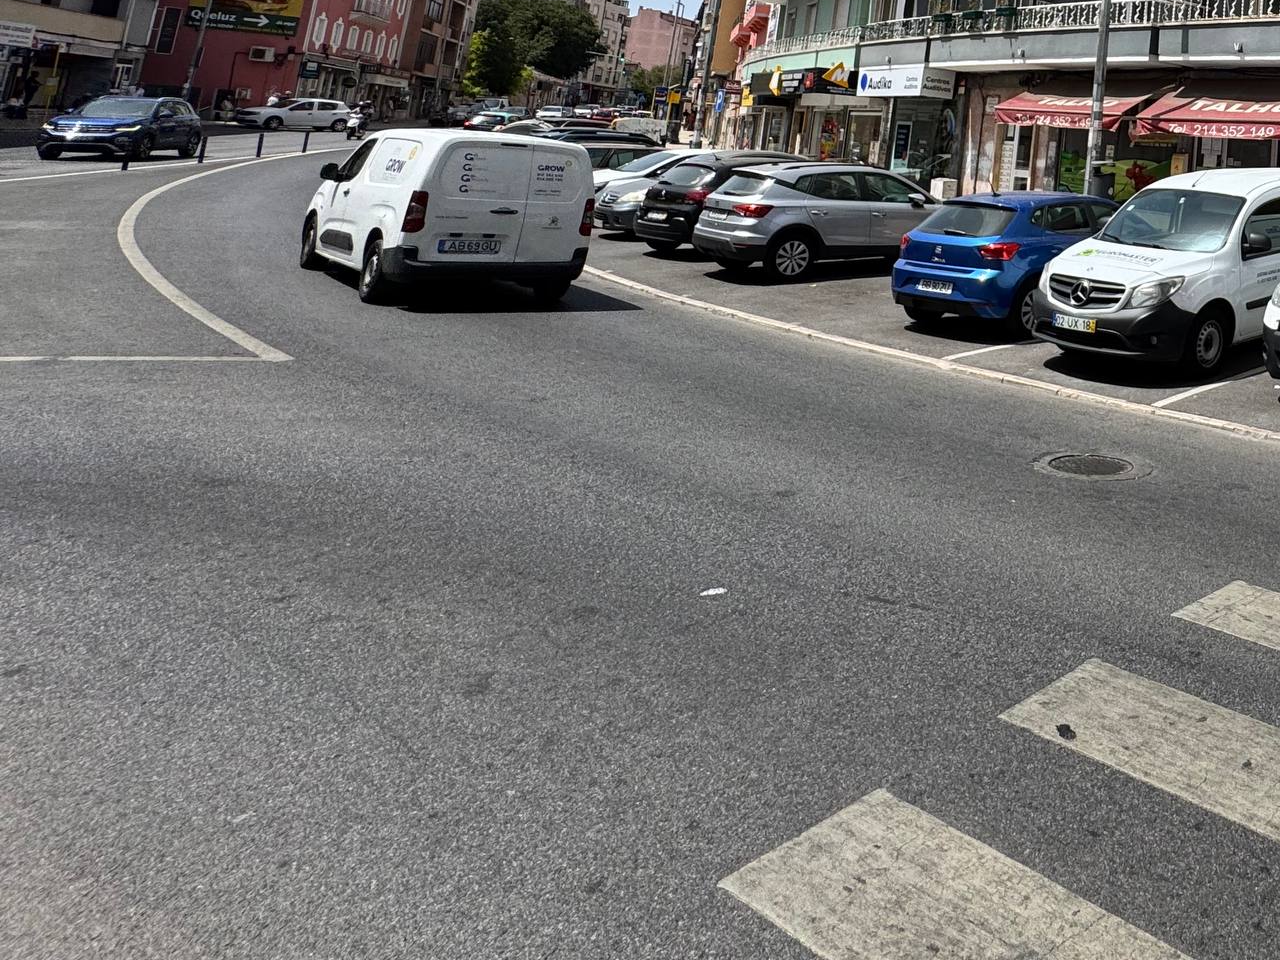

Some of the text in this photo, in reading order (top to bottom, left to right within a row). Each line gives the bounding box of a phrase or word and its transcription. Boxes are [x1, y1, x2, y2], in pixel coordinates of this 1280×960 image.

[868, 76, 892, 90] Audika
[926, 76, 950, 85] Centros
[923, 84, 952, 93] Auditivos
[1052, 115, 1071, 126] 352
[1193, 124, 1217, 136] 214
[1221, 125, 1245, 137] 352
[1250, 126, 1275, 137] 149
[537, 165, 565, 173] GROW
[1067, 318, 1080, 330] UX
